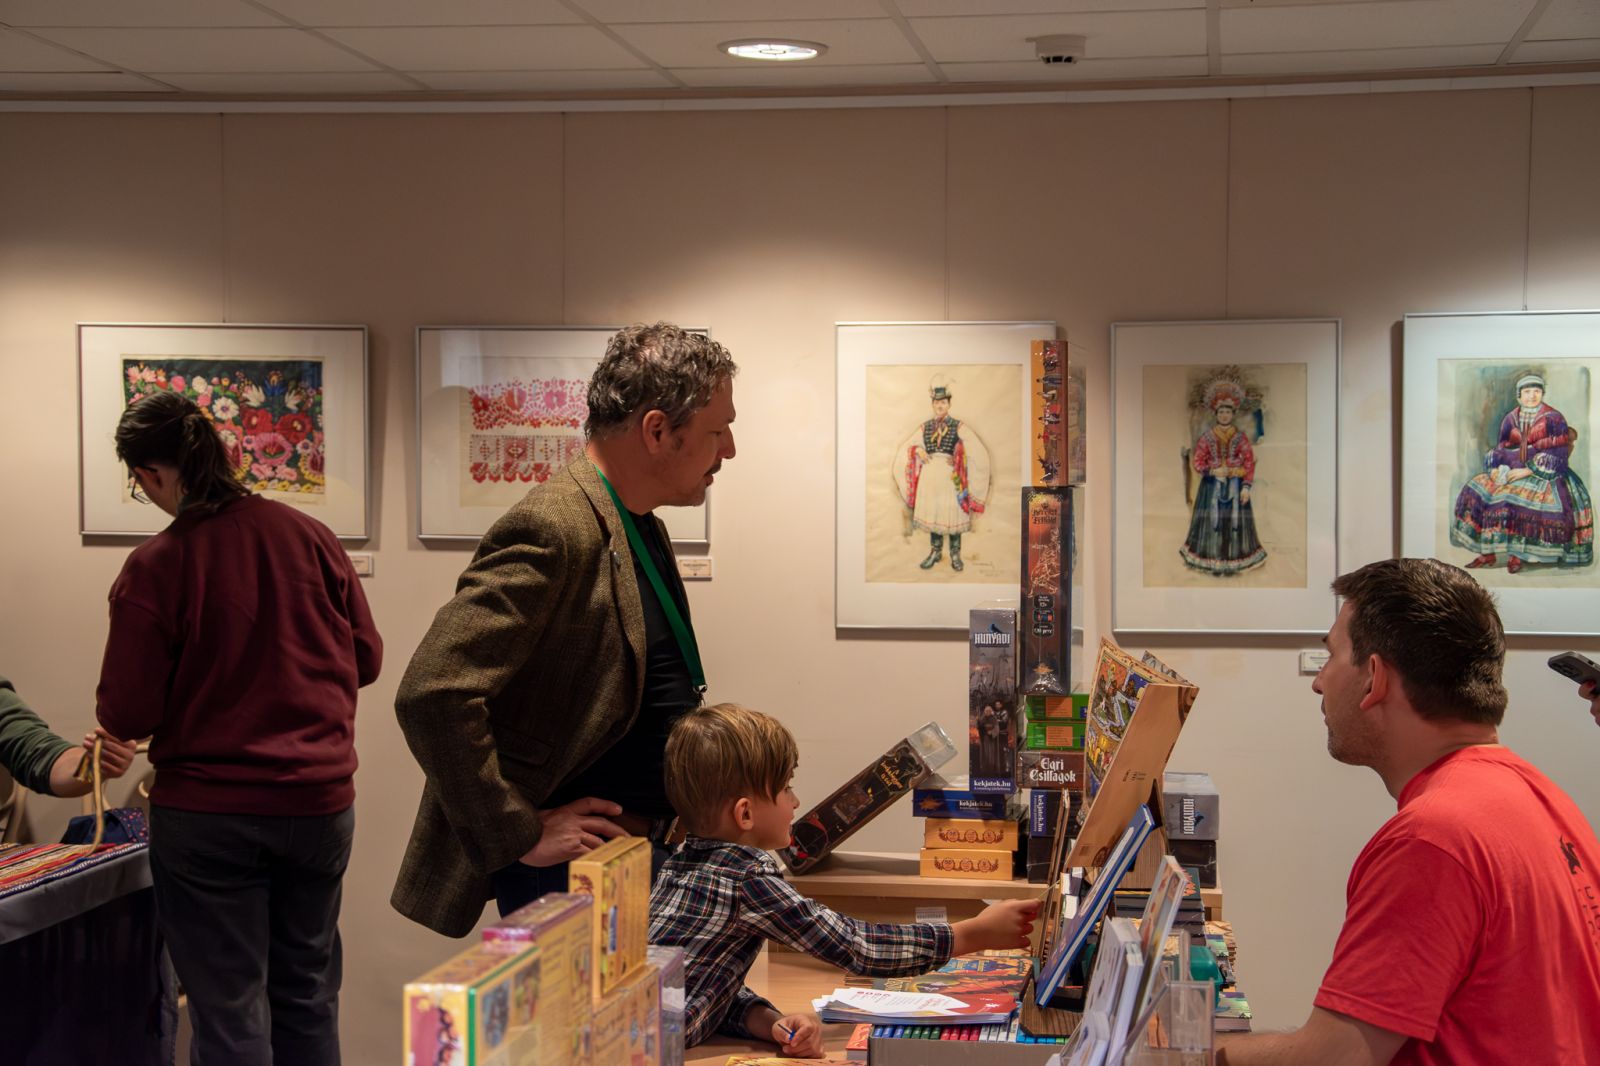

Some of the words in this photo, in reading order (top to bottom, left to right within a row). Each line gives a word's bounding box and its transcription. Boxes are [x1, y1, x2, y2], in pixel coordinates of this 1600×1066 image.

[974, 633, 1010, 645] HUNYADI
[1040, 757, 1064, 771] Egri
[1029, 769, 1076, 784] Csillagok
[973, 780, 1011, 788] kekjatek.hu
[1036, 794, 1044, 832] kekjatek.hu
[1183, 798, 1195, 835] HUNYADI
